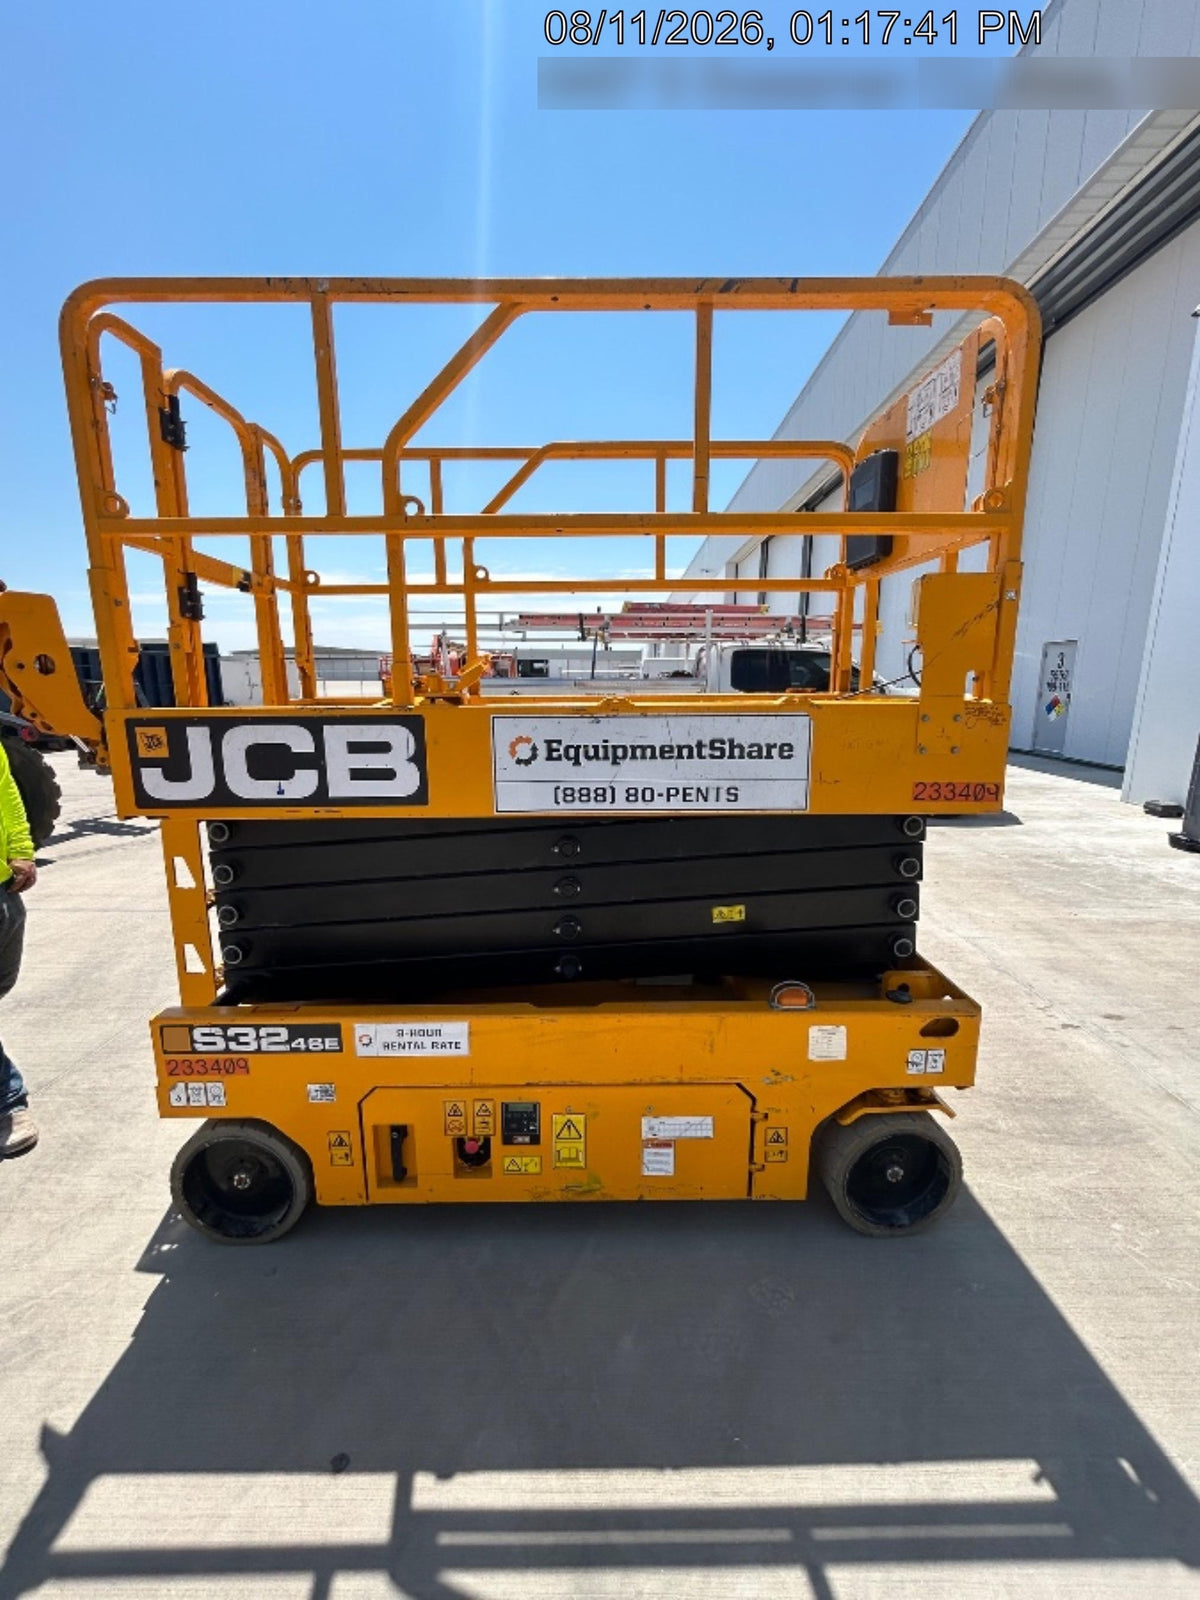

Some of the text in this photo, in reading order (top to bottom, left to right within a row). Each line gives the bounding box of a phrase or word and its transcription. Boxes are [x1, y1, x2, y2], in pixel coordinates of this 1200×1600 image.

[140, 724, 420, 800] JCB
[544, 738, 794, 766] EquipmentShare
[554, 785, 616, 805] (888)
[431, 1041, 462, 1050] RATE
[166, 1057, 250, 1076] 233409
